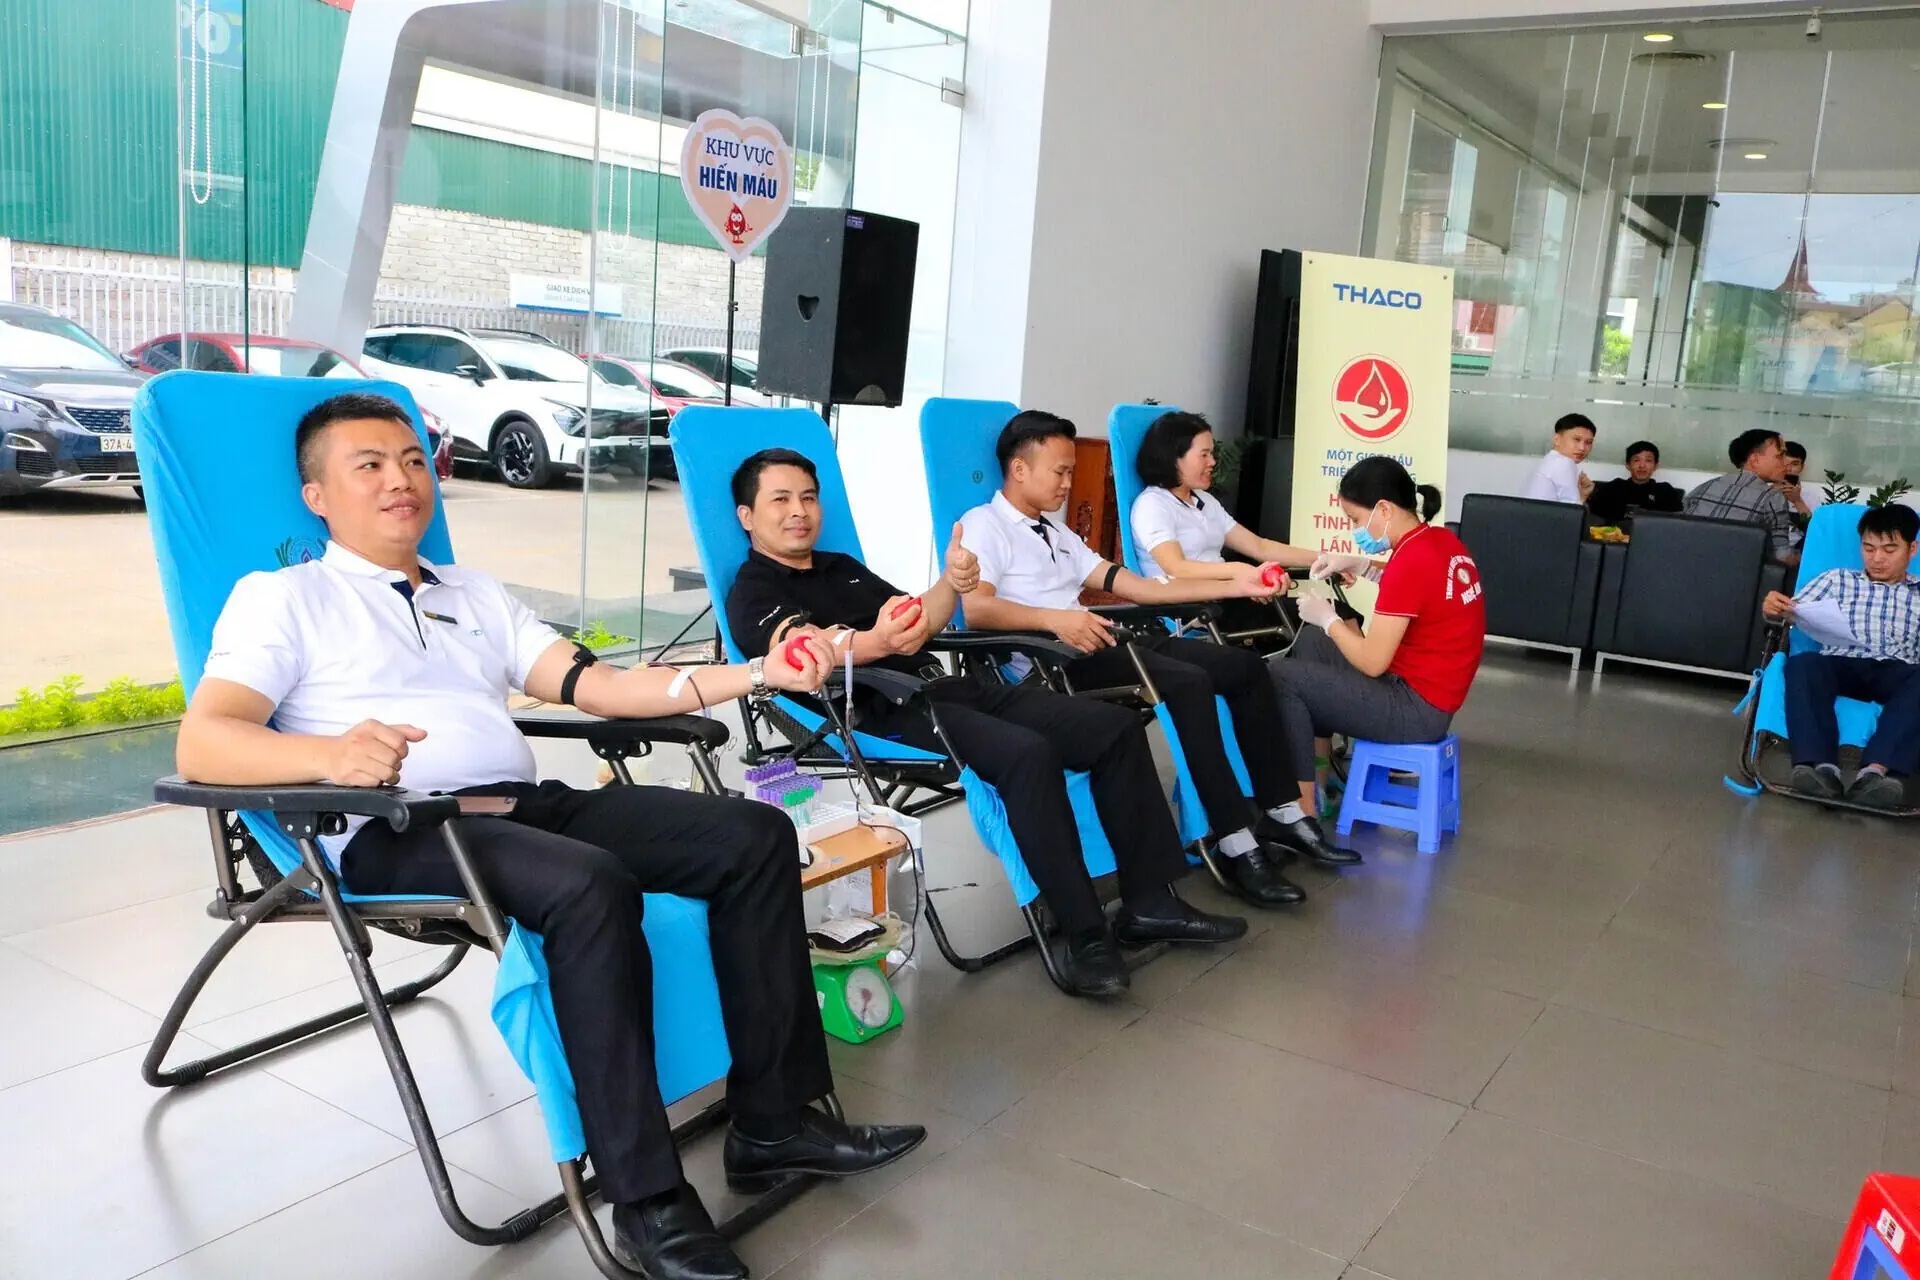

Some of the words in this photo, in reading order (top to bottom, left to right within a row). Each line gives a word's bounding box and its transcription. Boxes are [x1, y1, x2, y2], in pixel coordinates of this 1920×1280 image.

[706, 137, 740, 159] KHU
[744, 144, 775, 166] VỰC
[699, 163, 738, 193] HIẾN
[742, 173, 777, 199] MÁU
[1333, 283, 1422, 310] THACO
[1327, 449, 1353, 464] MỘT
[1313, 512, 1351, 531] TÌNH
